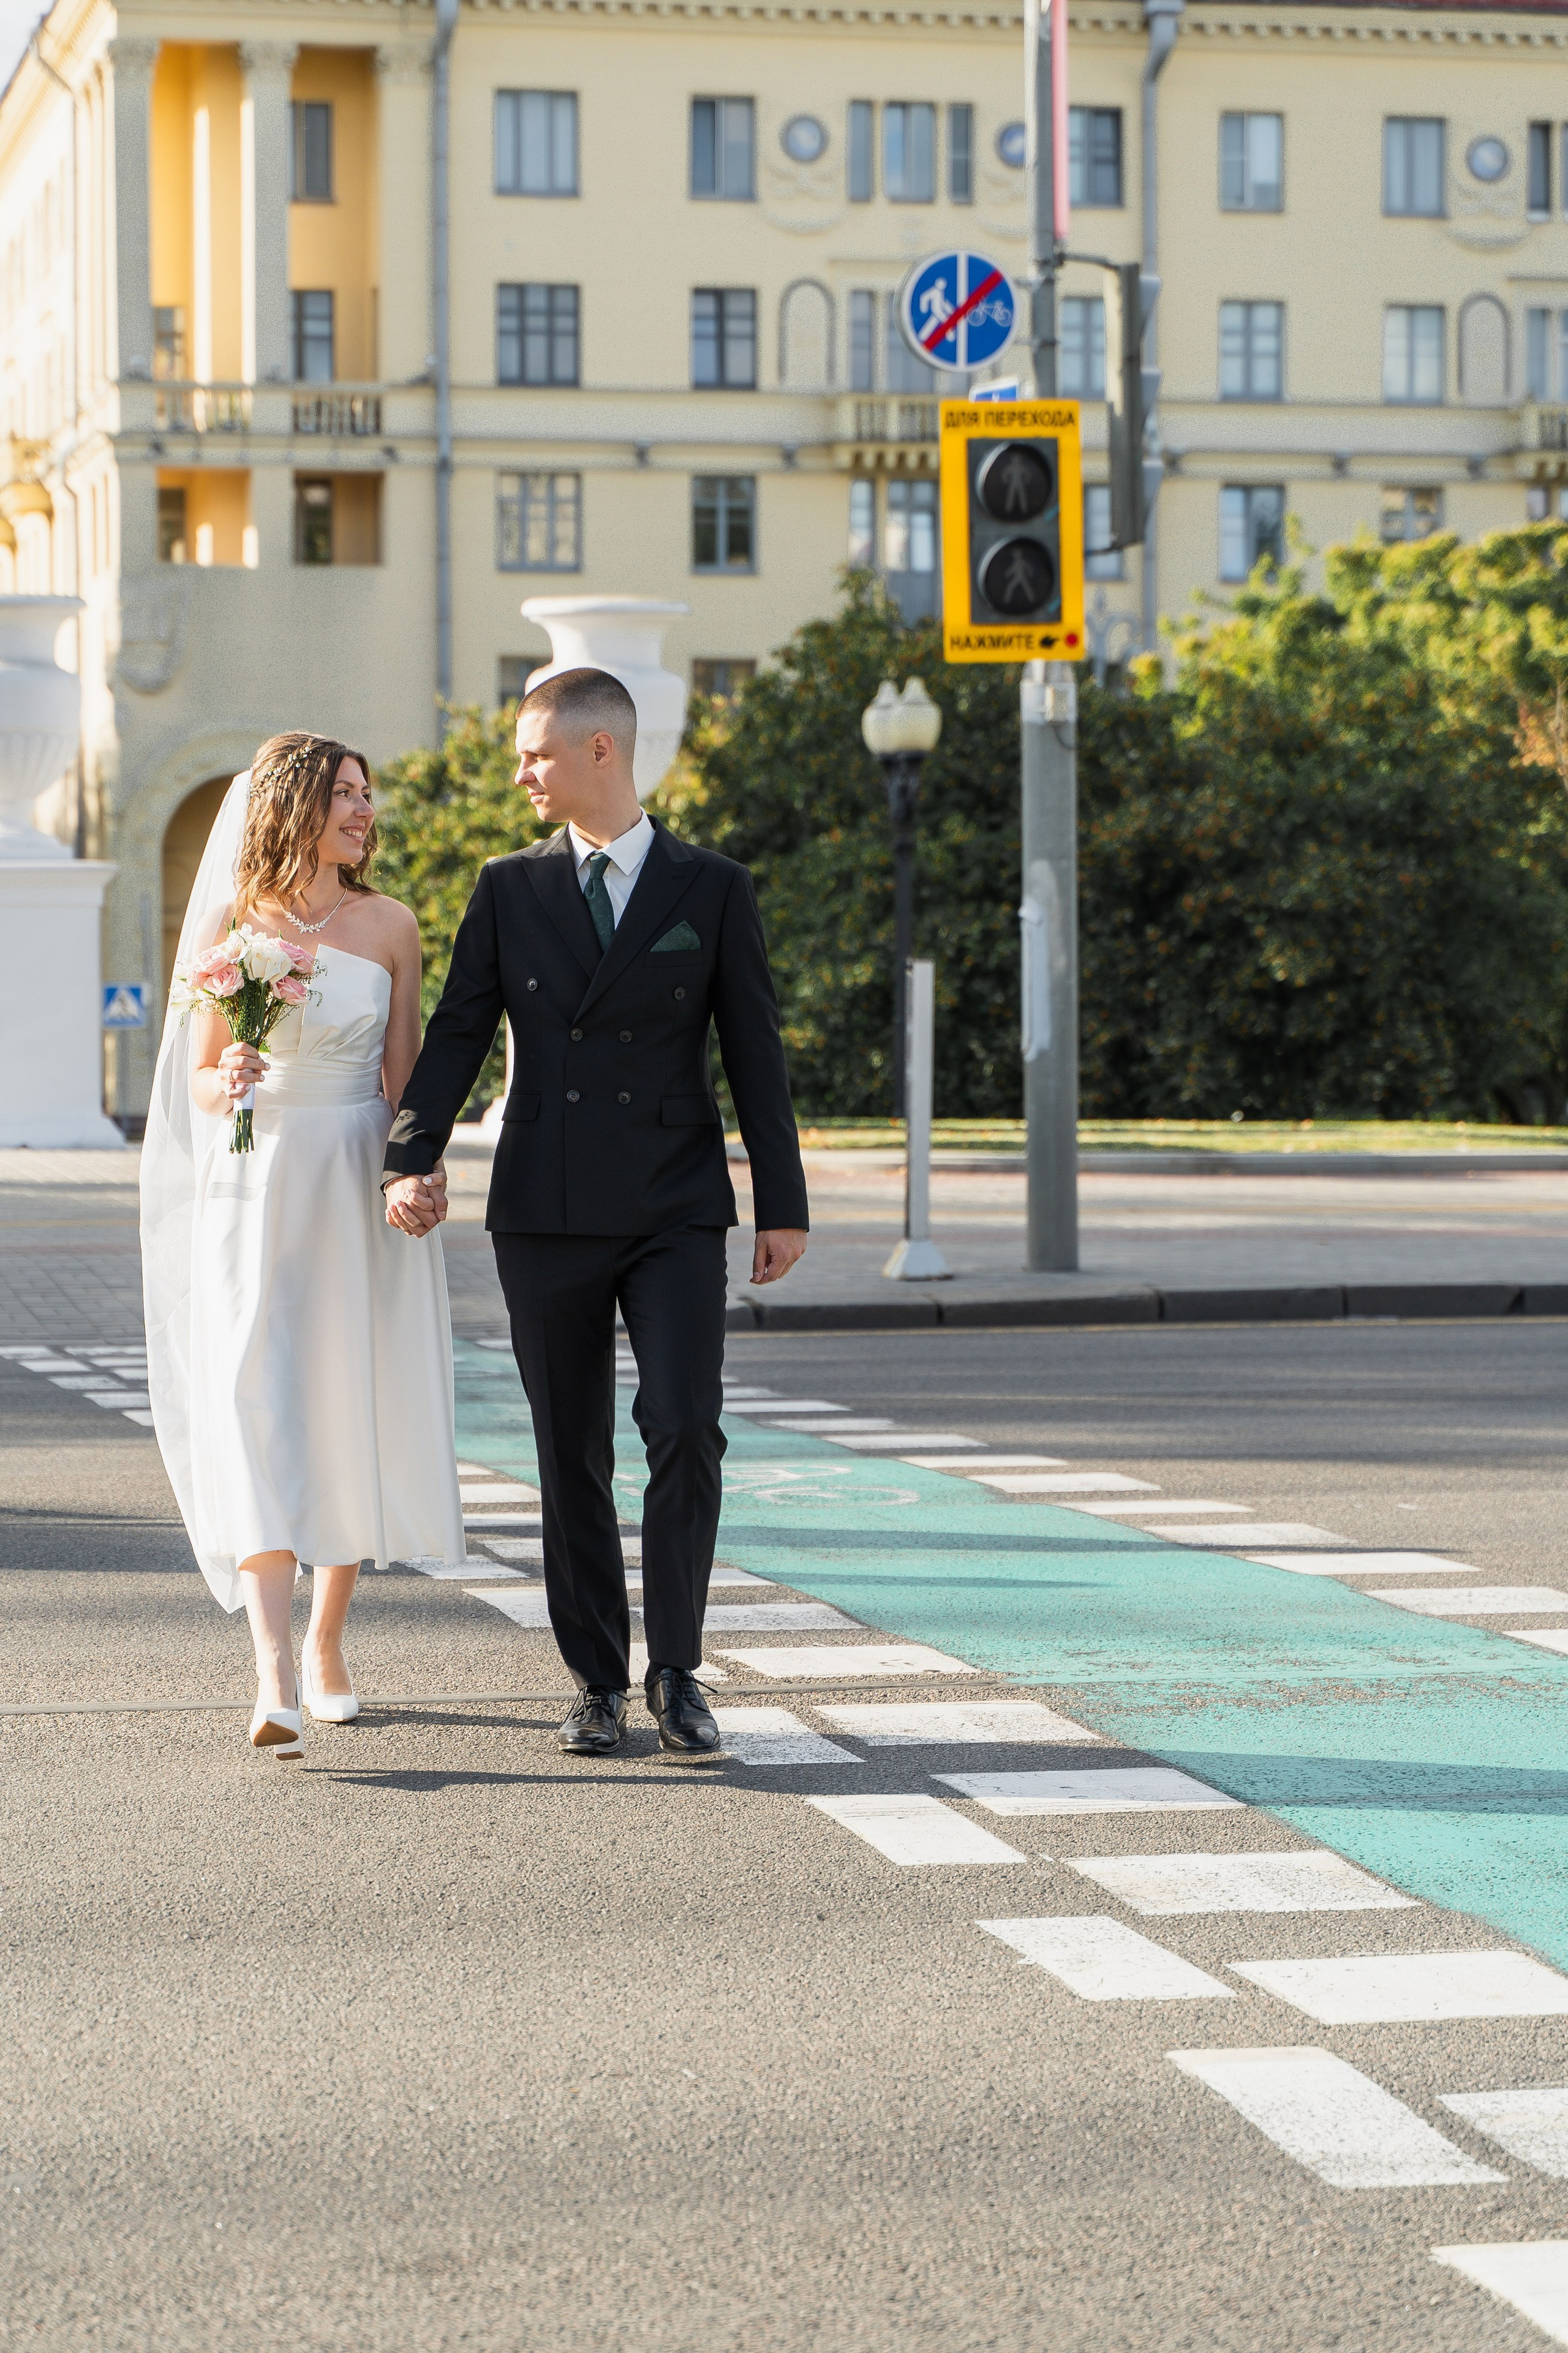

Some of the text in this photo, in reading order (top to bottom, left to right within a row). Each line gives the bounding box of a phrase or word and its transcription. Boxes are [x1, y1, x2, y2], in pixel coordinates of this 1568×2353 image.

[945, 410, 1074, 428] ДЛЯ ПЕРЕХОДА
[950, 634, 1033, 650] НАЖМИТЕ
